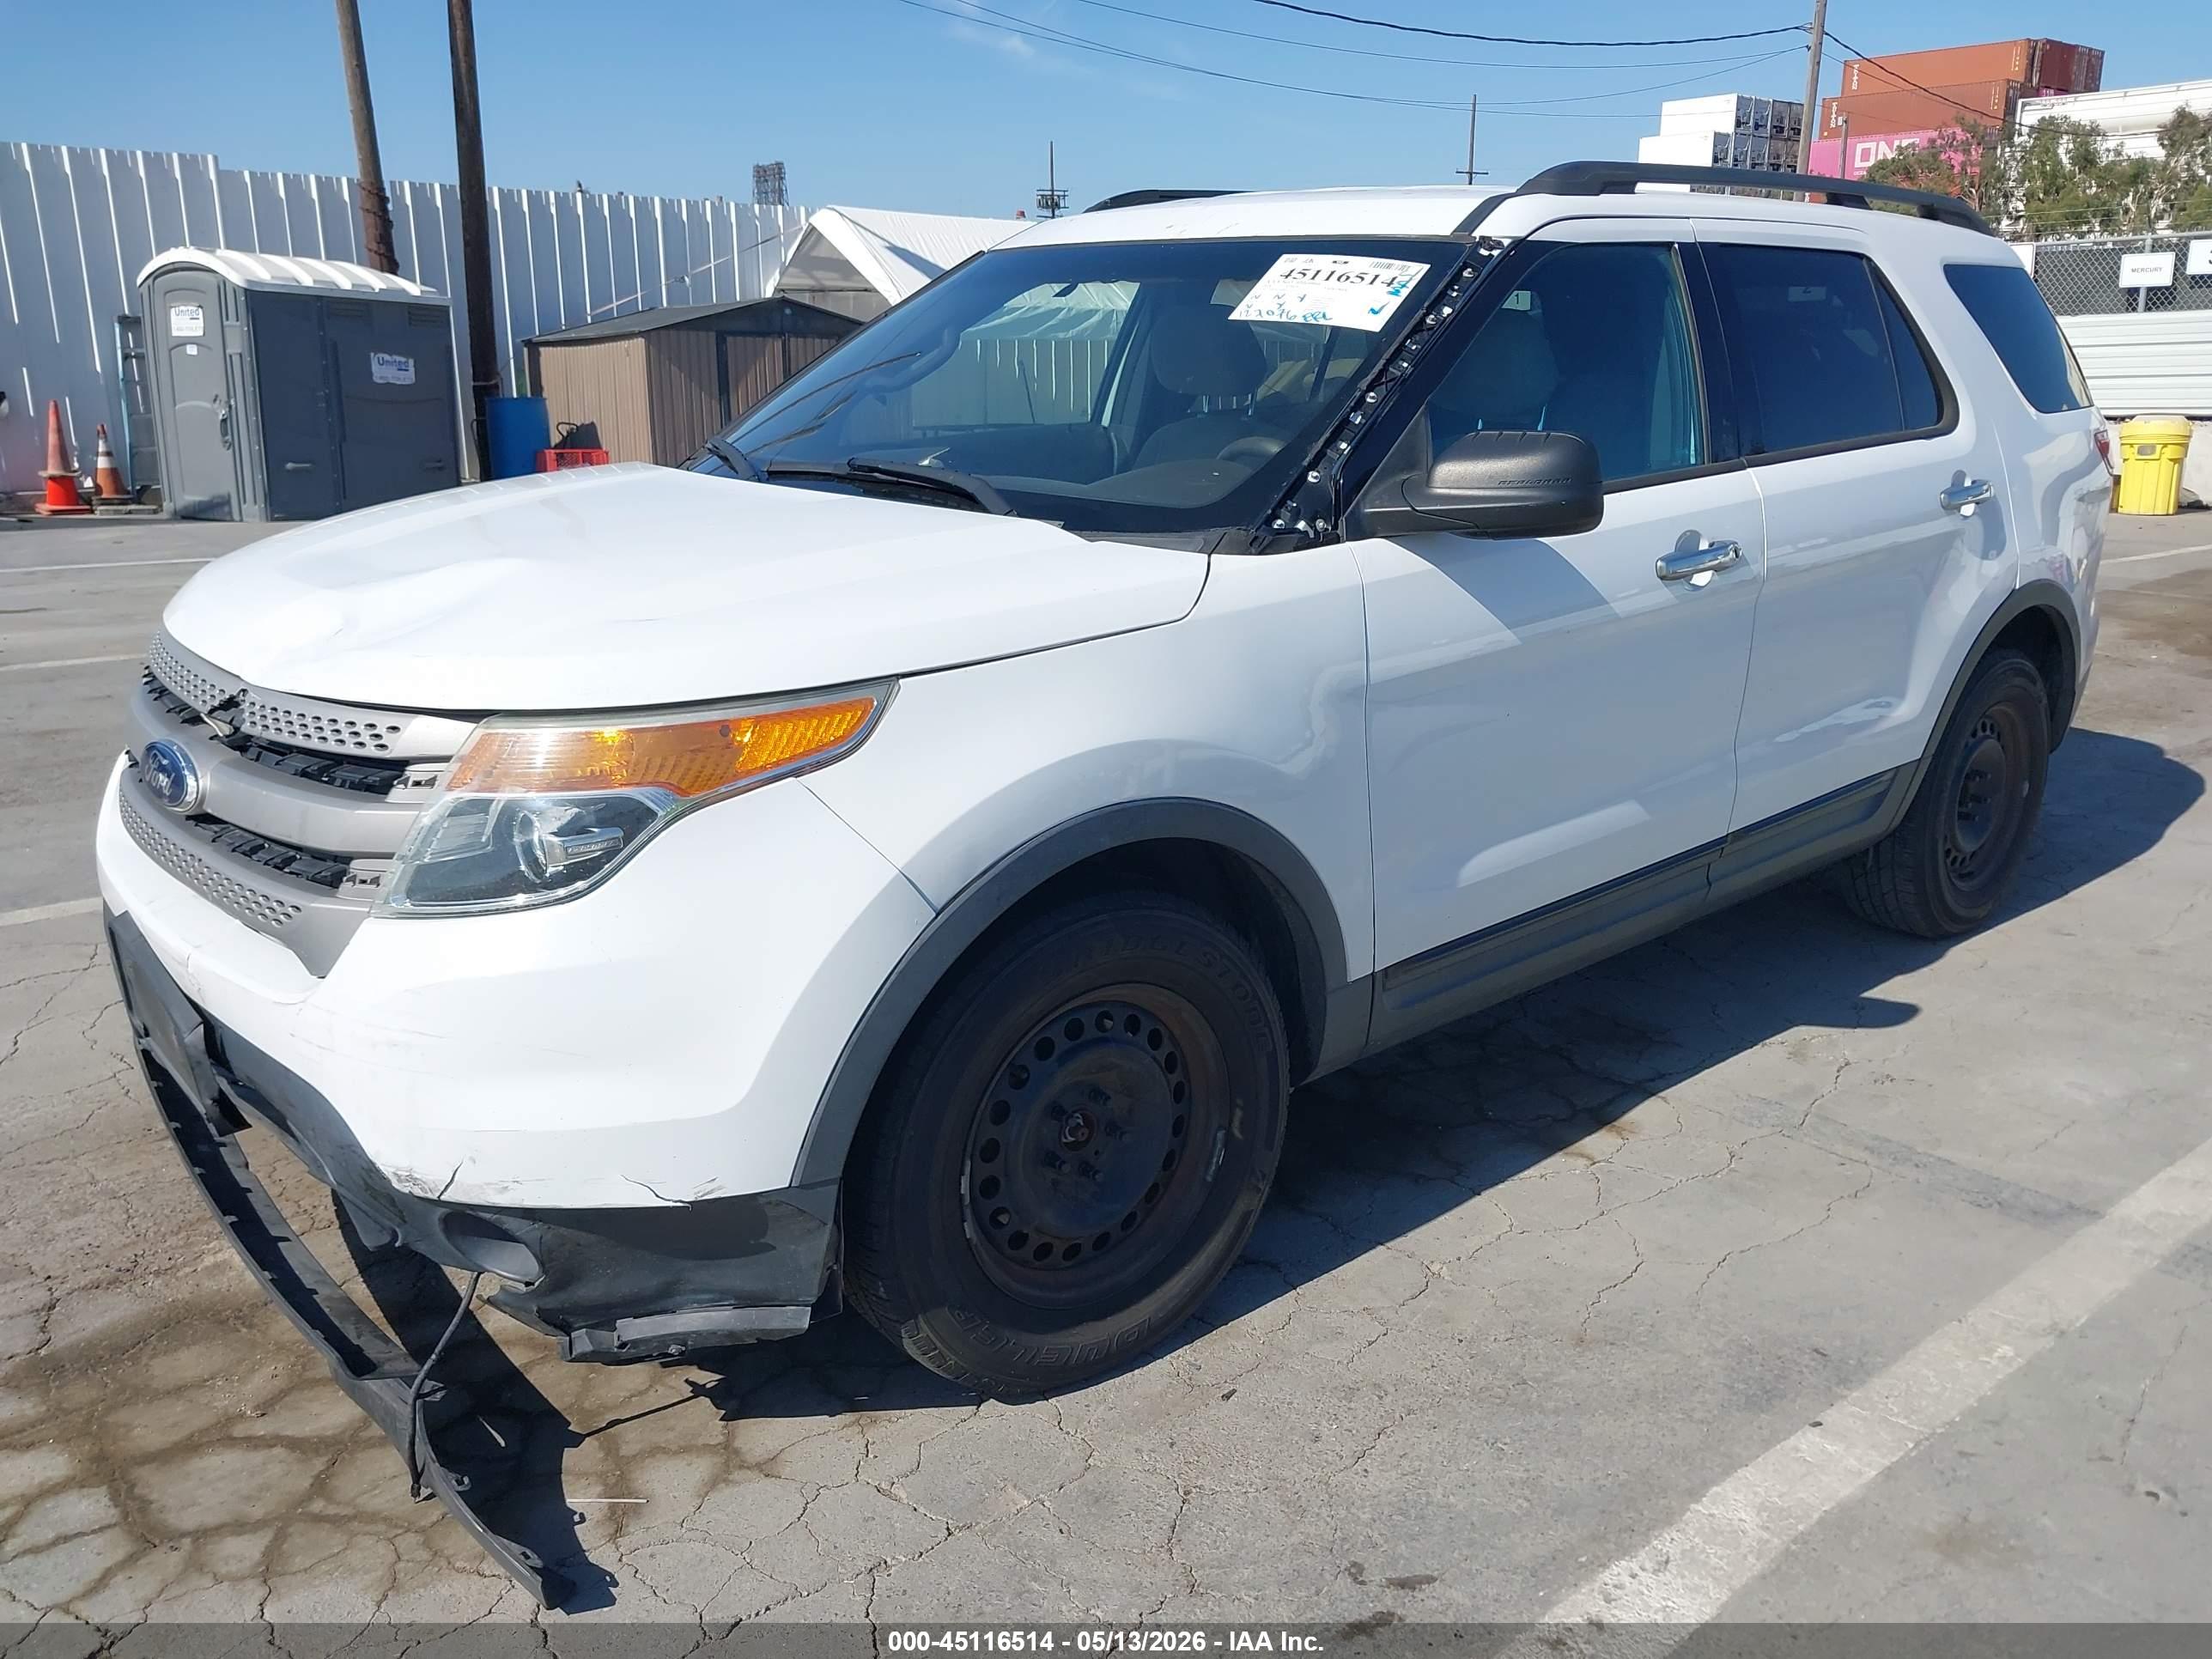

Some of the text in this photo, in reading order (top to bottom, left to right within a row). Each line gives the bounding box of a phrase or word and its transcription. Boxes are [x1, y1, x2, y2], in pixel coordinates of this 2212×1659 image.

[1279, 267, 1400, 288] 45116514
[174, 308, 200, 317] United
[377, 356, 410, 368] United
[144, 749, 176, 796] Ford
[945, 1305, 1151, 1366] DUELER
